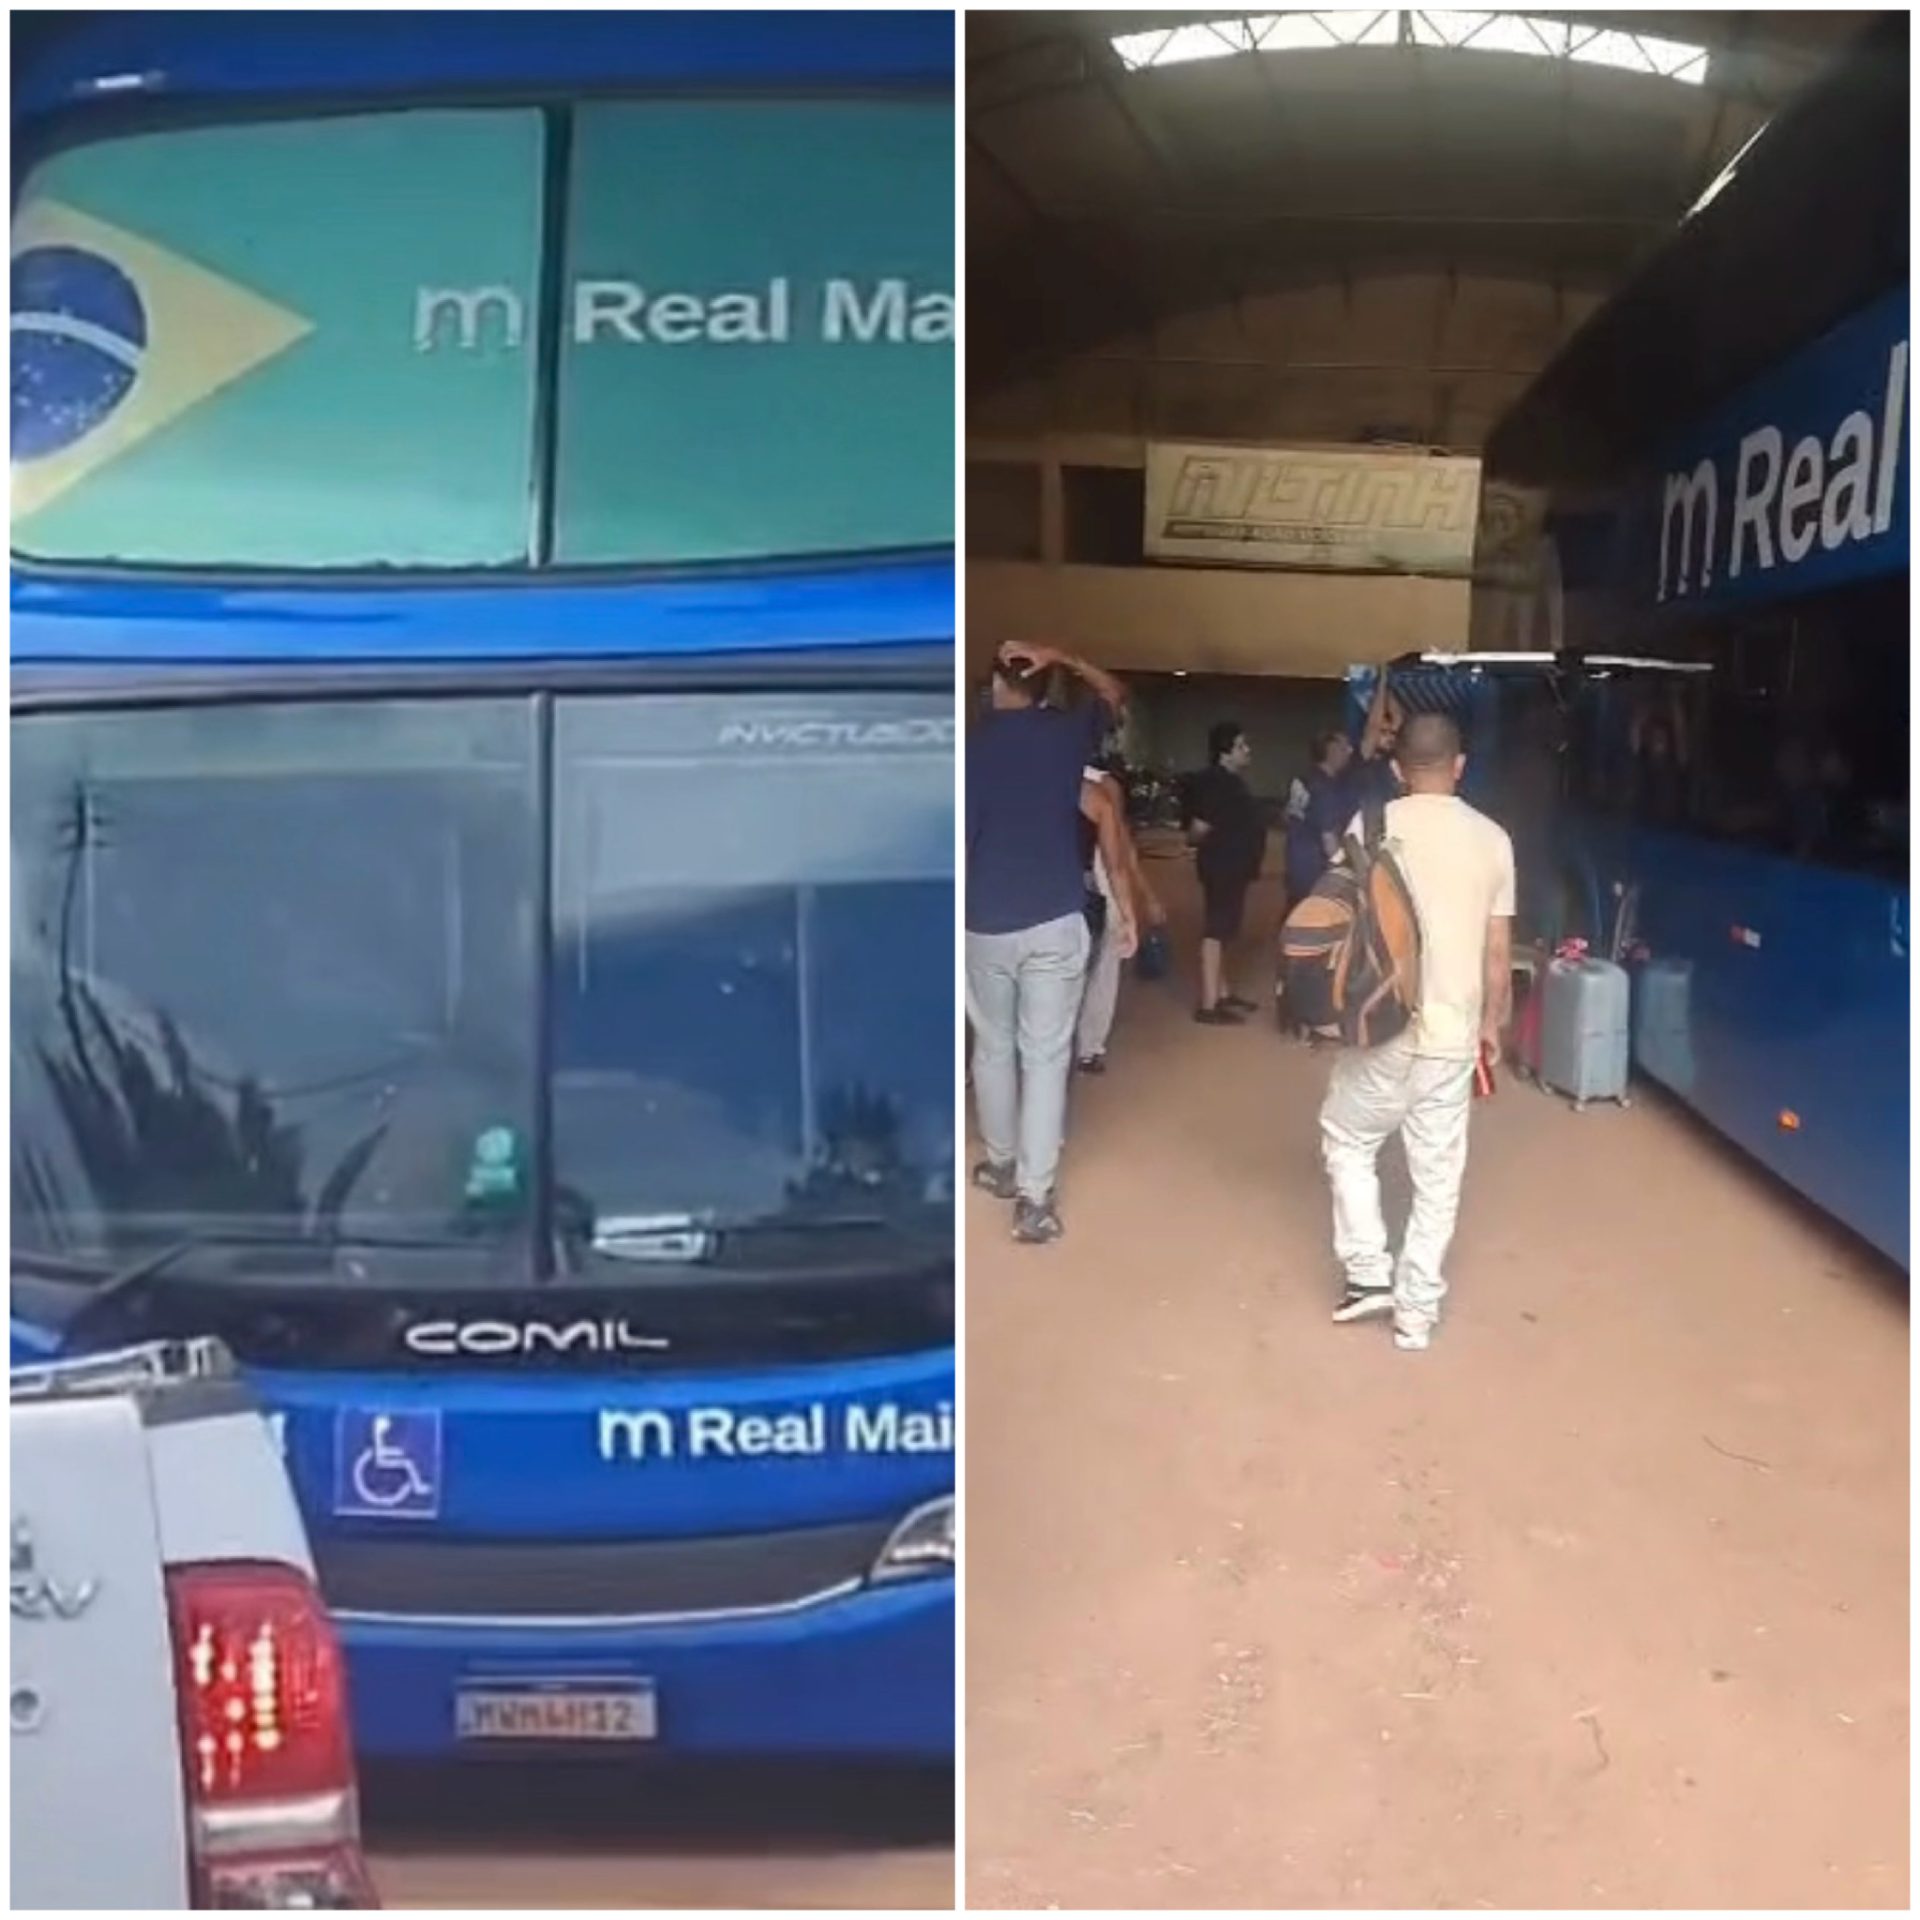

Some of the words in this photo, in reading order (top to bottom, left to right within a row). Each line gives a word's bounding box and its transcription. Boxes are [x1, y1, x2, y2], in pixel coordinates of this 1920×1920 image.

[573, 277, 789, 343] Real
[821, 279, 955, 343] Ma
[1728, 339, 1909, 579] Real
[405, 1320, 669, 1353] COMIL
[688, 1403, 825, 1456] Real
[846, 1401, 955, 1453] Mai
